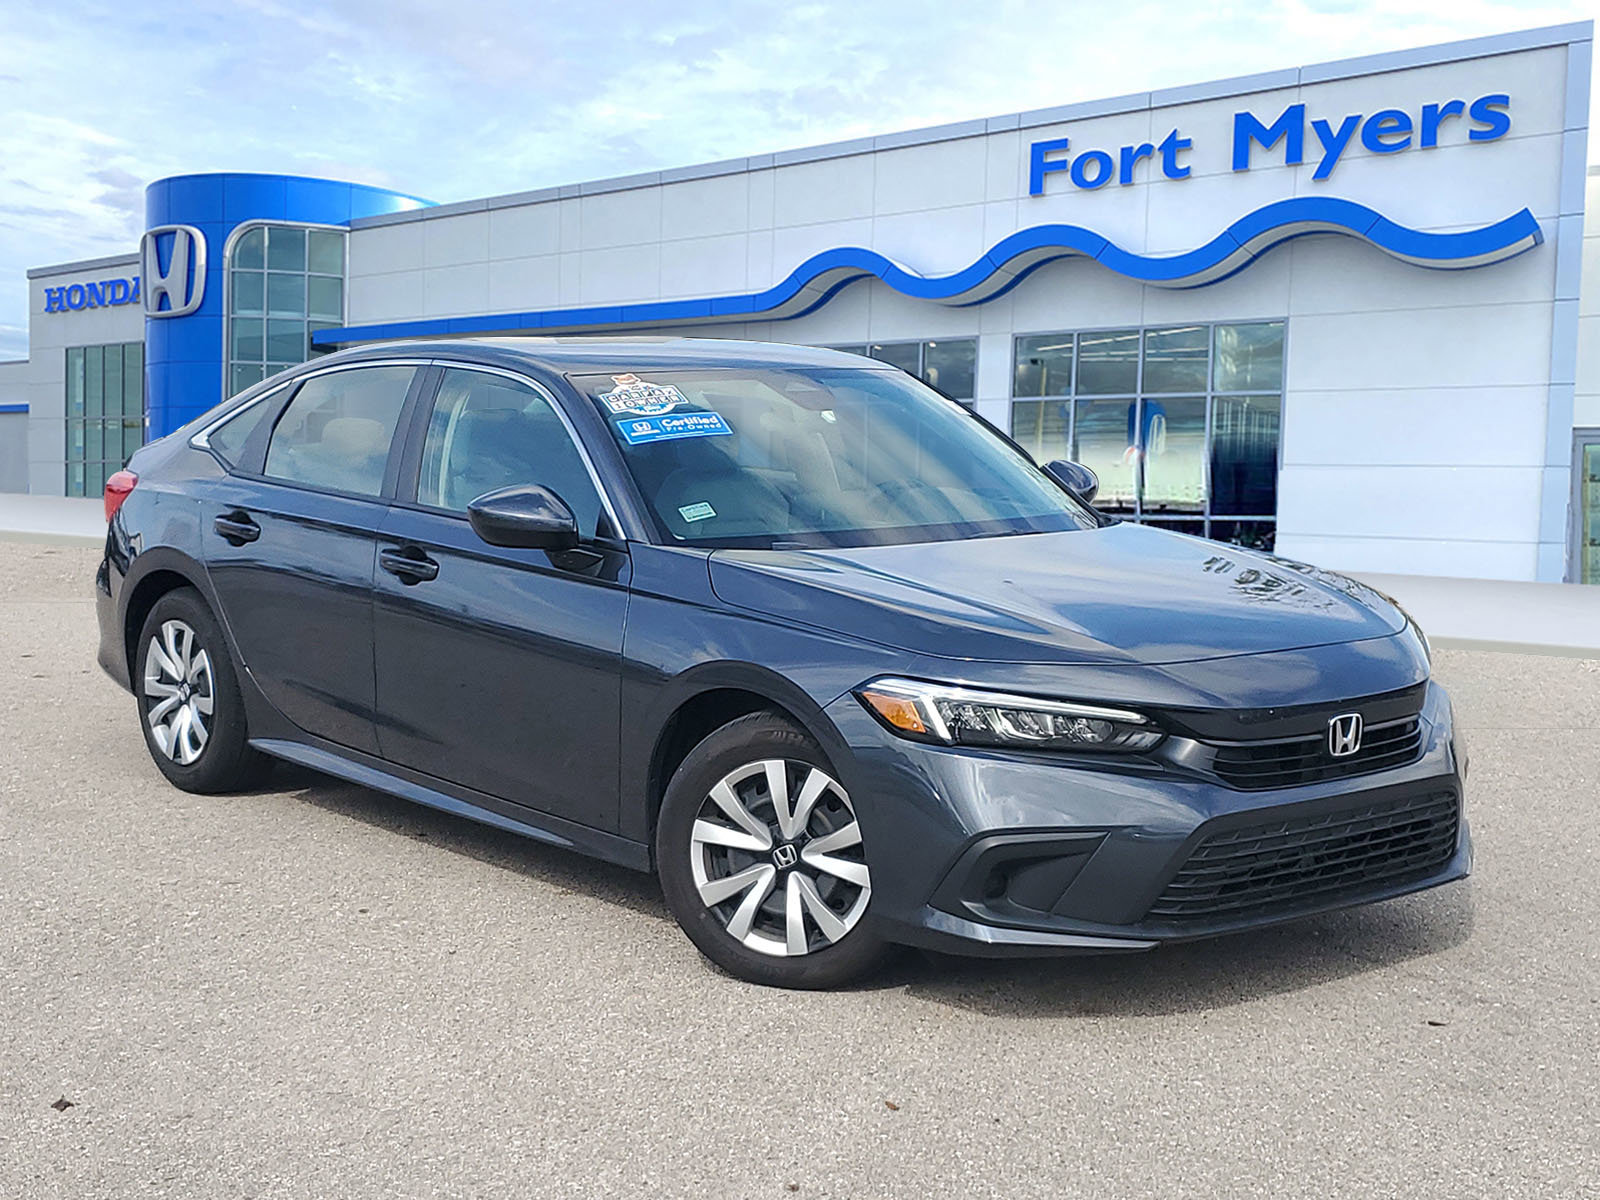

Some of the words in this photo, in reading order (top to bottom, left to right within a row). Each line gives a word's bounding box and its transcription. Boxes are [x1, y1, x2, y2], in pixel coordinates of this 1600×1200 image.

[1029, 127, 1193, 197] Fort
[1232, 94, 1512, 182] Myers
[661, 416, 717, 427] Certified
[666, 423, 722, 431] Pre-Owned
